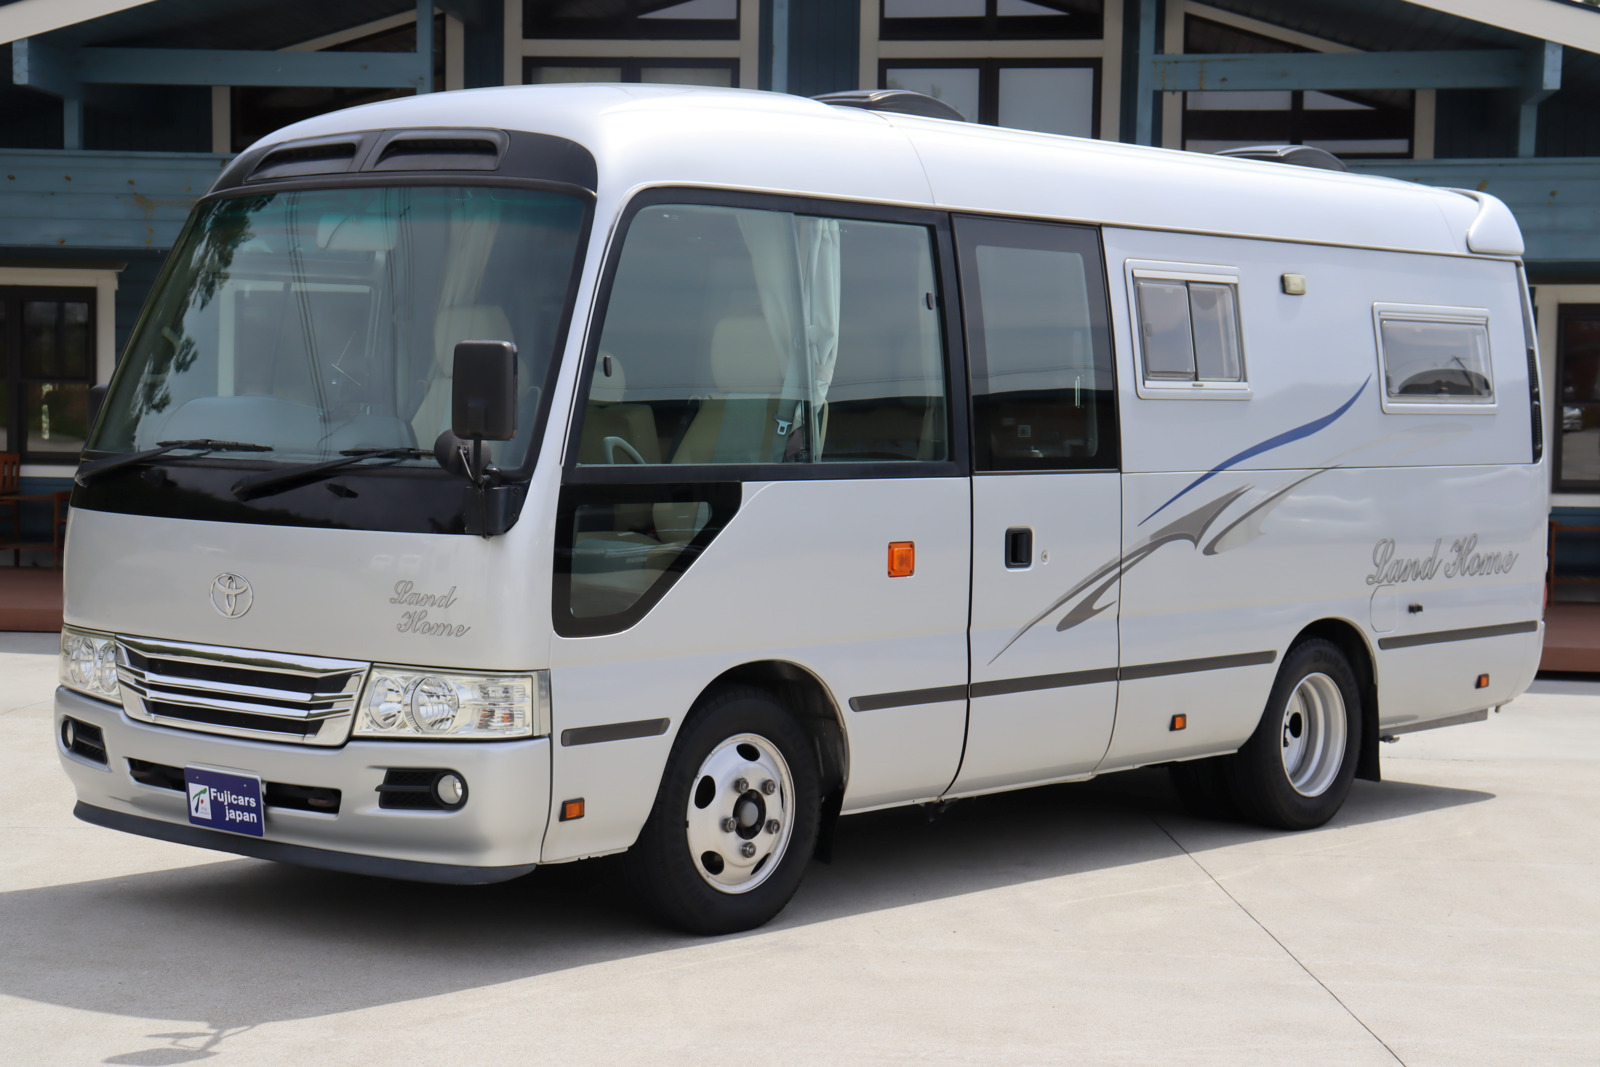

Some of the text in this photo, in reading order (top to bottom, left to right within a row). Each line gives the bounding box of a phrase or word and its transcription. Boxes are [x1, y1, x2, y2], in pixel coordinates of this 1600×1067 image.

[1366, 533, 1519, 585] Land Home
[388, 579, 458, 609] Land
[395, 609, 472, 638] Home
[210, 788, 256, 807] Fujicars
[225, 806, 257, 823] japan
